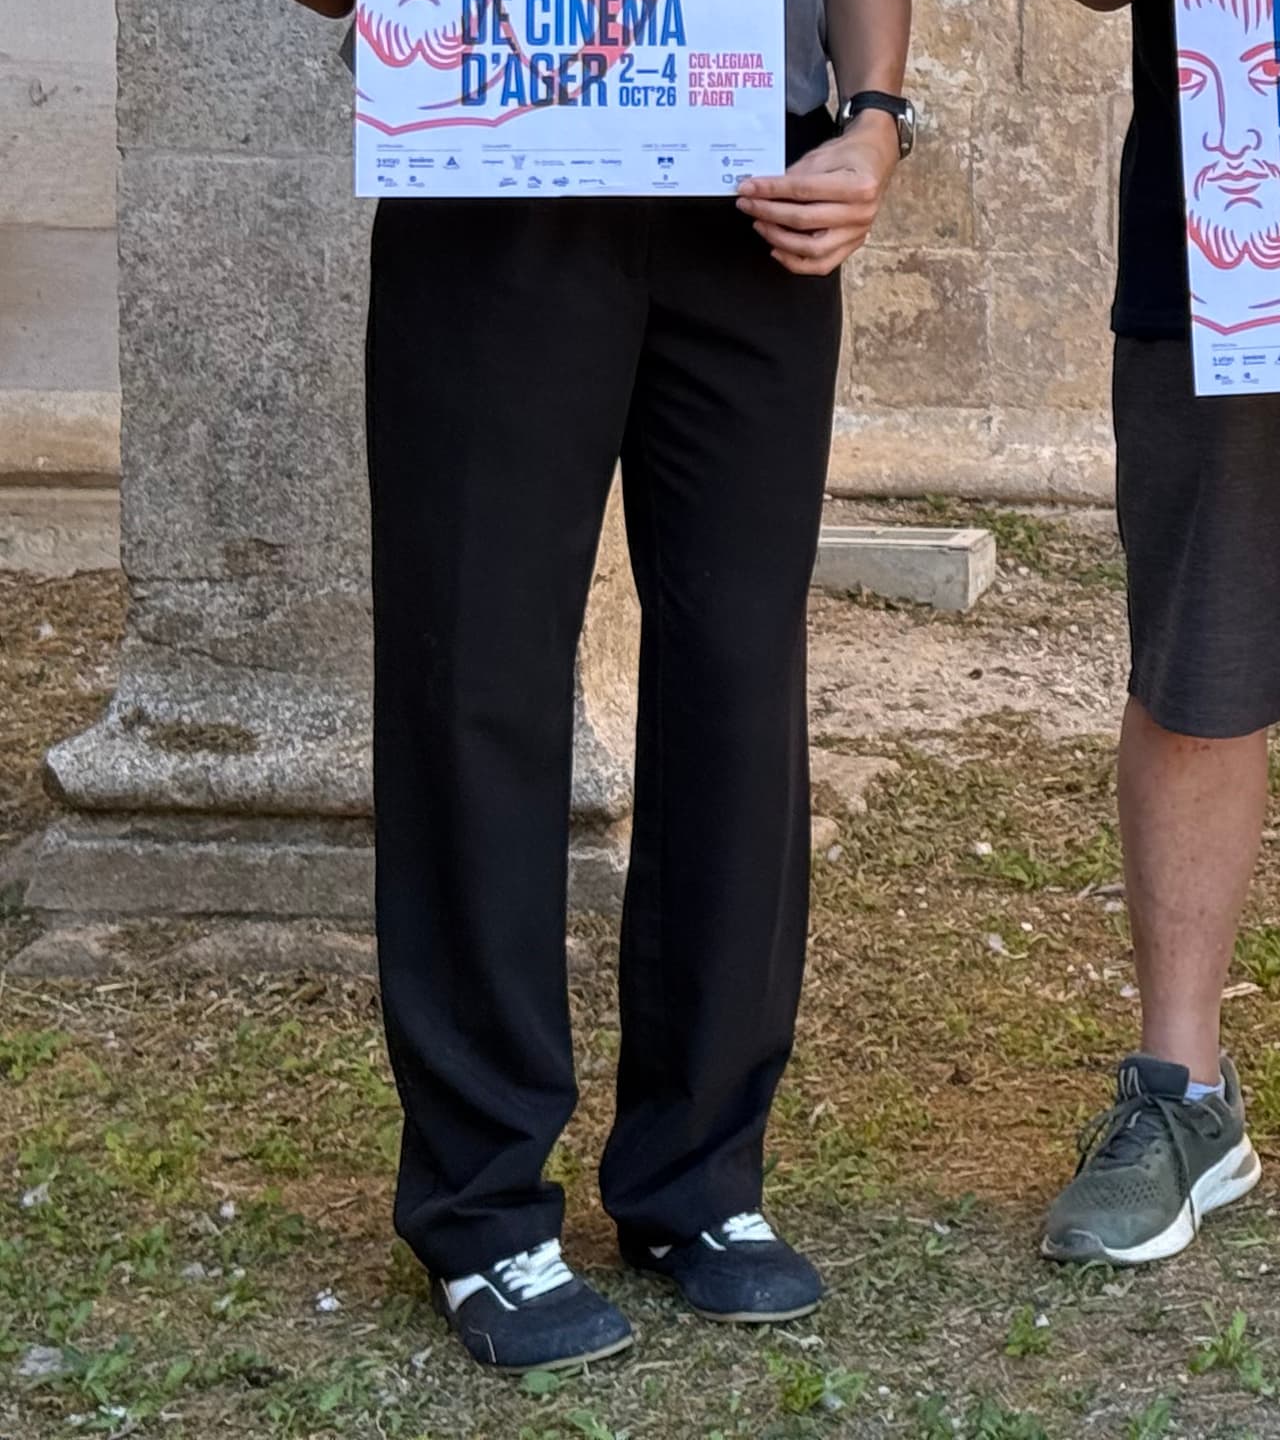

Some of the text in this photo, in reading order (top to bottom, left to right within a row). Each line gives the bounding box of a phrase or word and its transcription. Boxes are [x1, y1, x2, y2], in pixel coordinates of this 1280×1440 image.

[688, 71, 774, 88] DE SANT PERE
